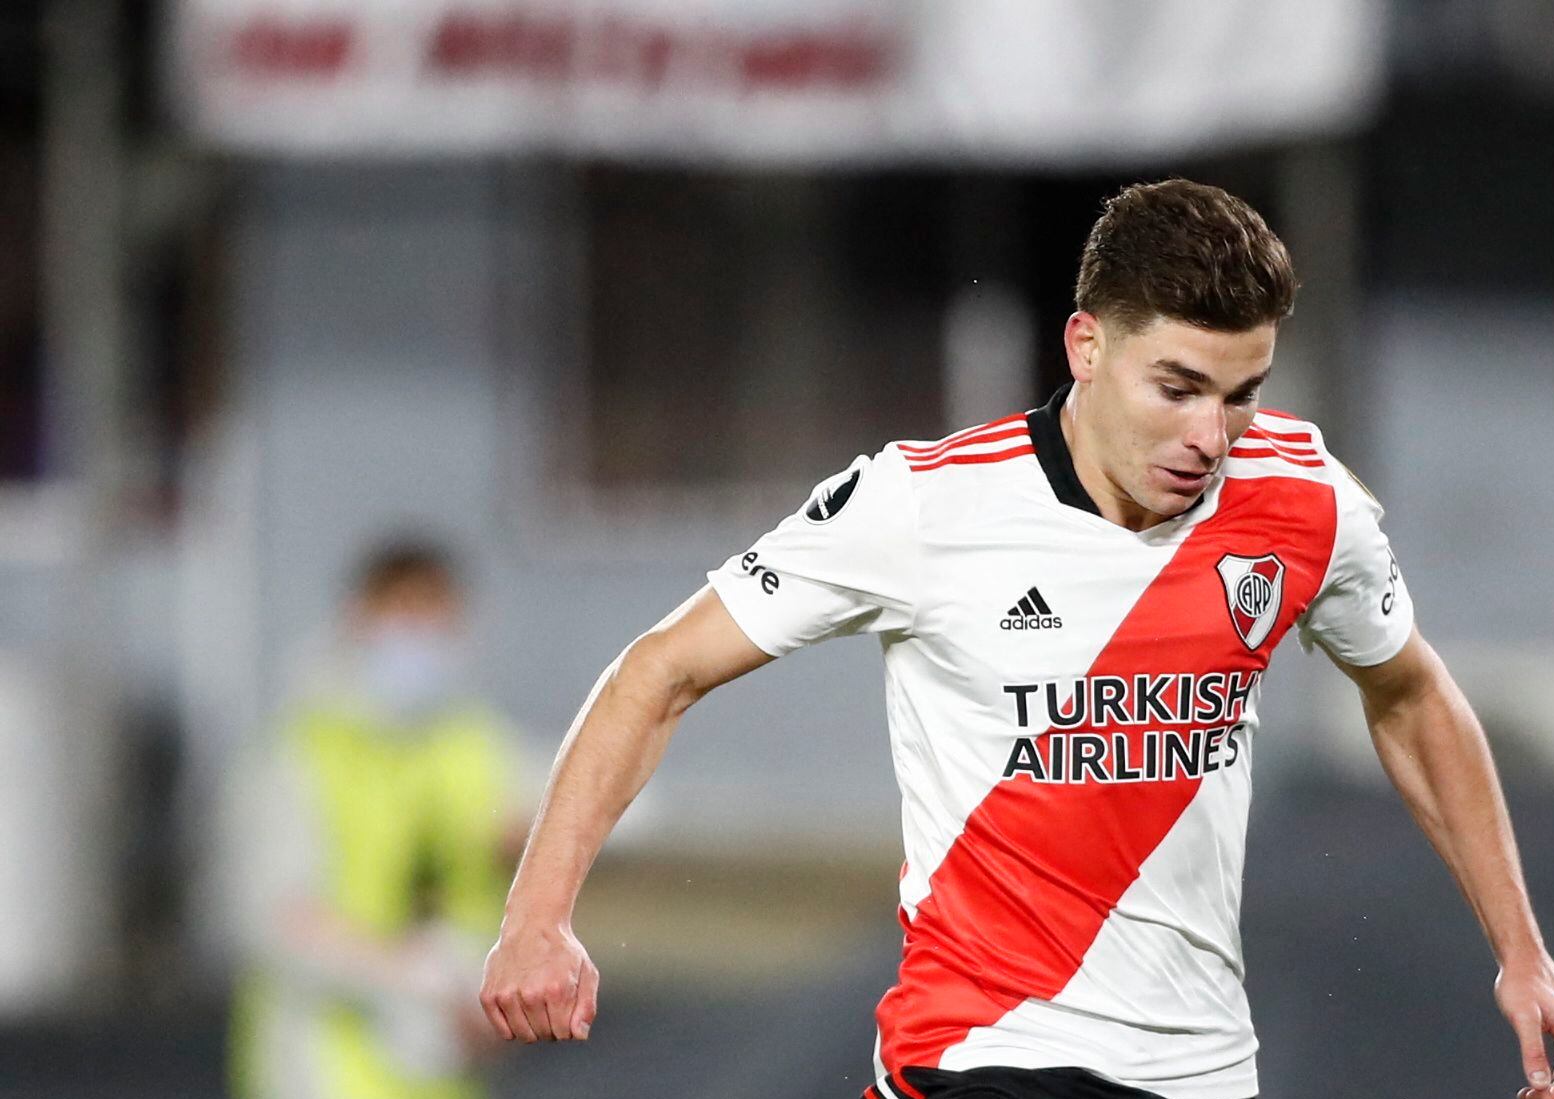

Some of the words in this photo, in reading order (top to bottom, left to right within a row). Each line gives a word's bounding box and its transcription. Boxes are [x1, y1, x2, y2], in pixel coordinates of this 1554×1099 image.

[741, 551, 780, 595] ere
[999, 615, 1063, 631] adidas
[1002, 671, 1256, 728] TURKISH
[1001, 723, 1248, 783] AIRLINES
